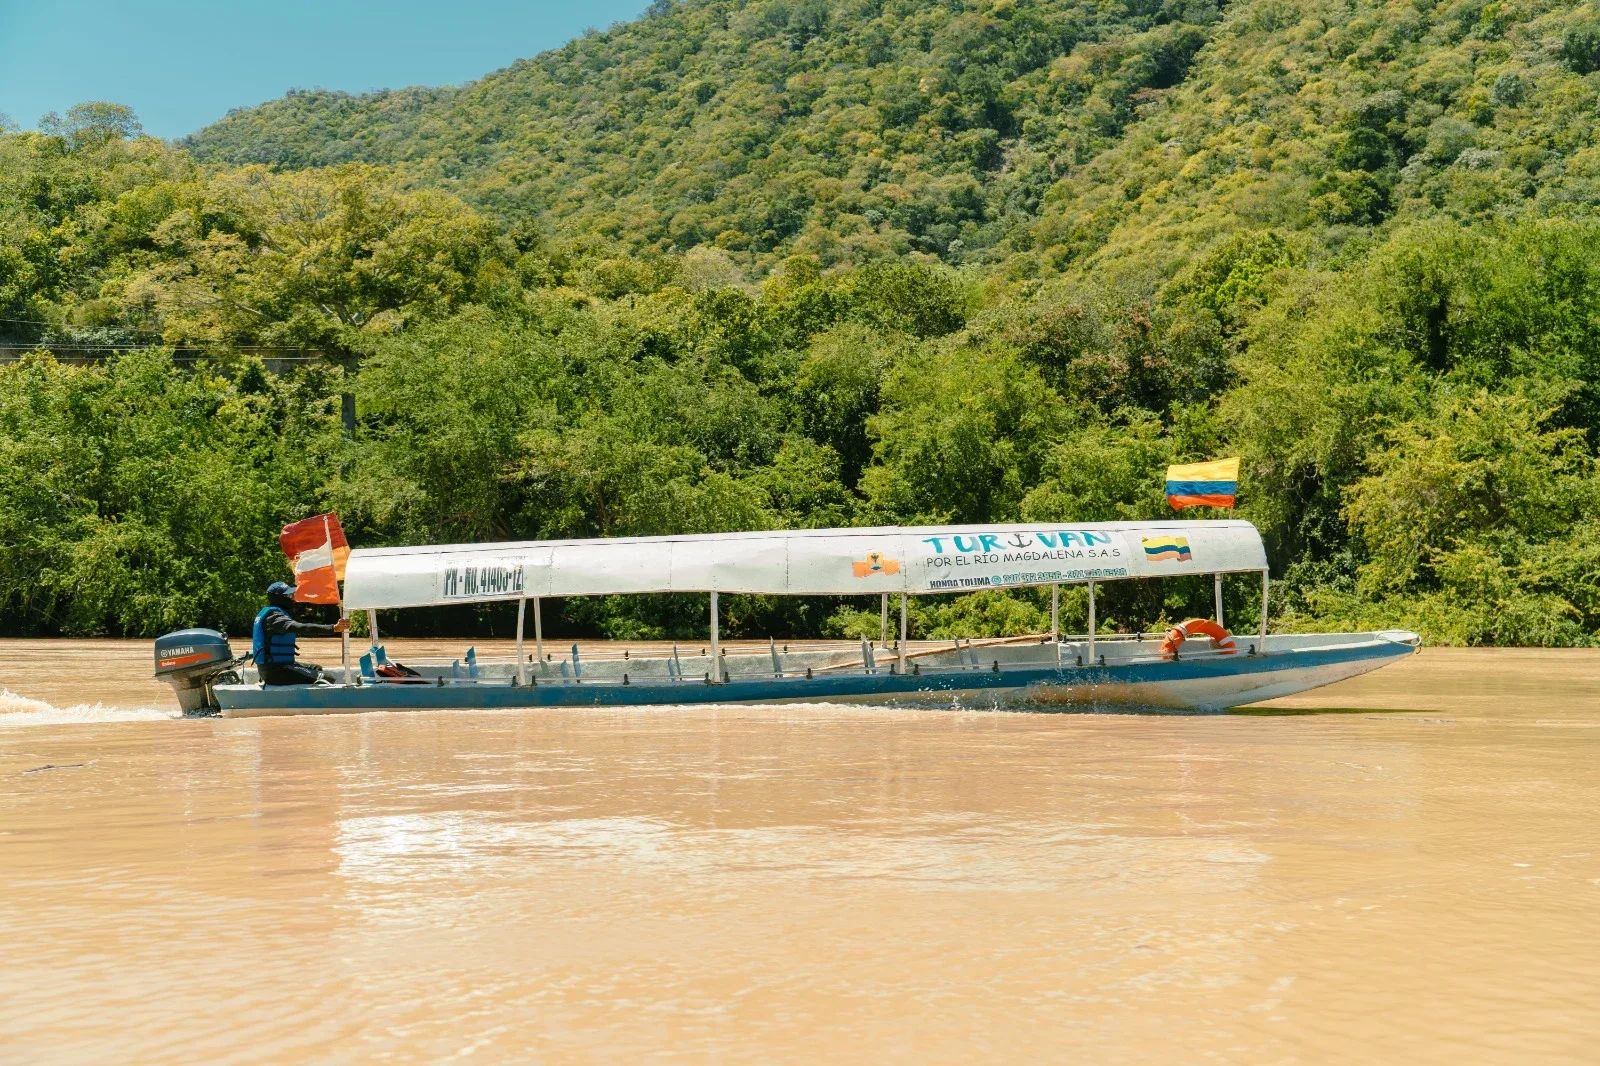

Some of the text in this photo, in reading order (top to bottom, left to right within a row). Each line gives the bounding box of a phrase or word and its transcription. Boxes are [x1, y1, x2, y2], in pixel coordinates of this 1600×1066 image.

[922, 532, 1112, 553] TUR VAN
[926, 557, 952, 568] POR
[956, 555, 970, 566] EL
[974, 552, 999, 564] RÍO
[1003, 549, 1084, 562] MAGDALENA
[959, 576, 991, 586] TOLIMA
[168, 646, 194, 656] YAMAHA
